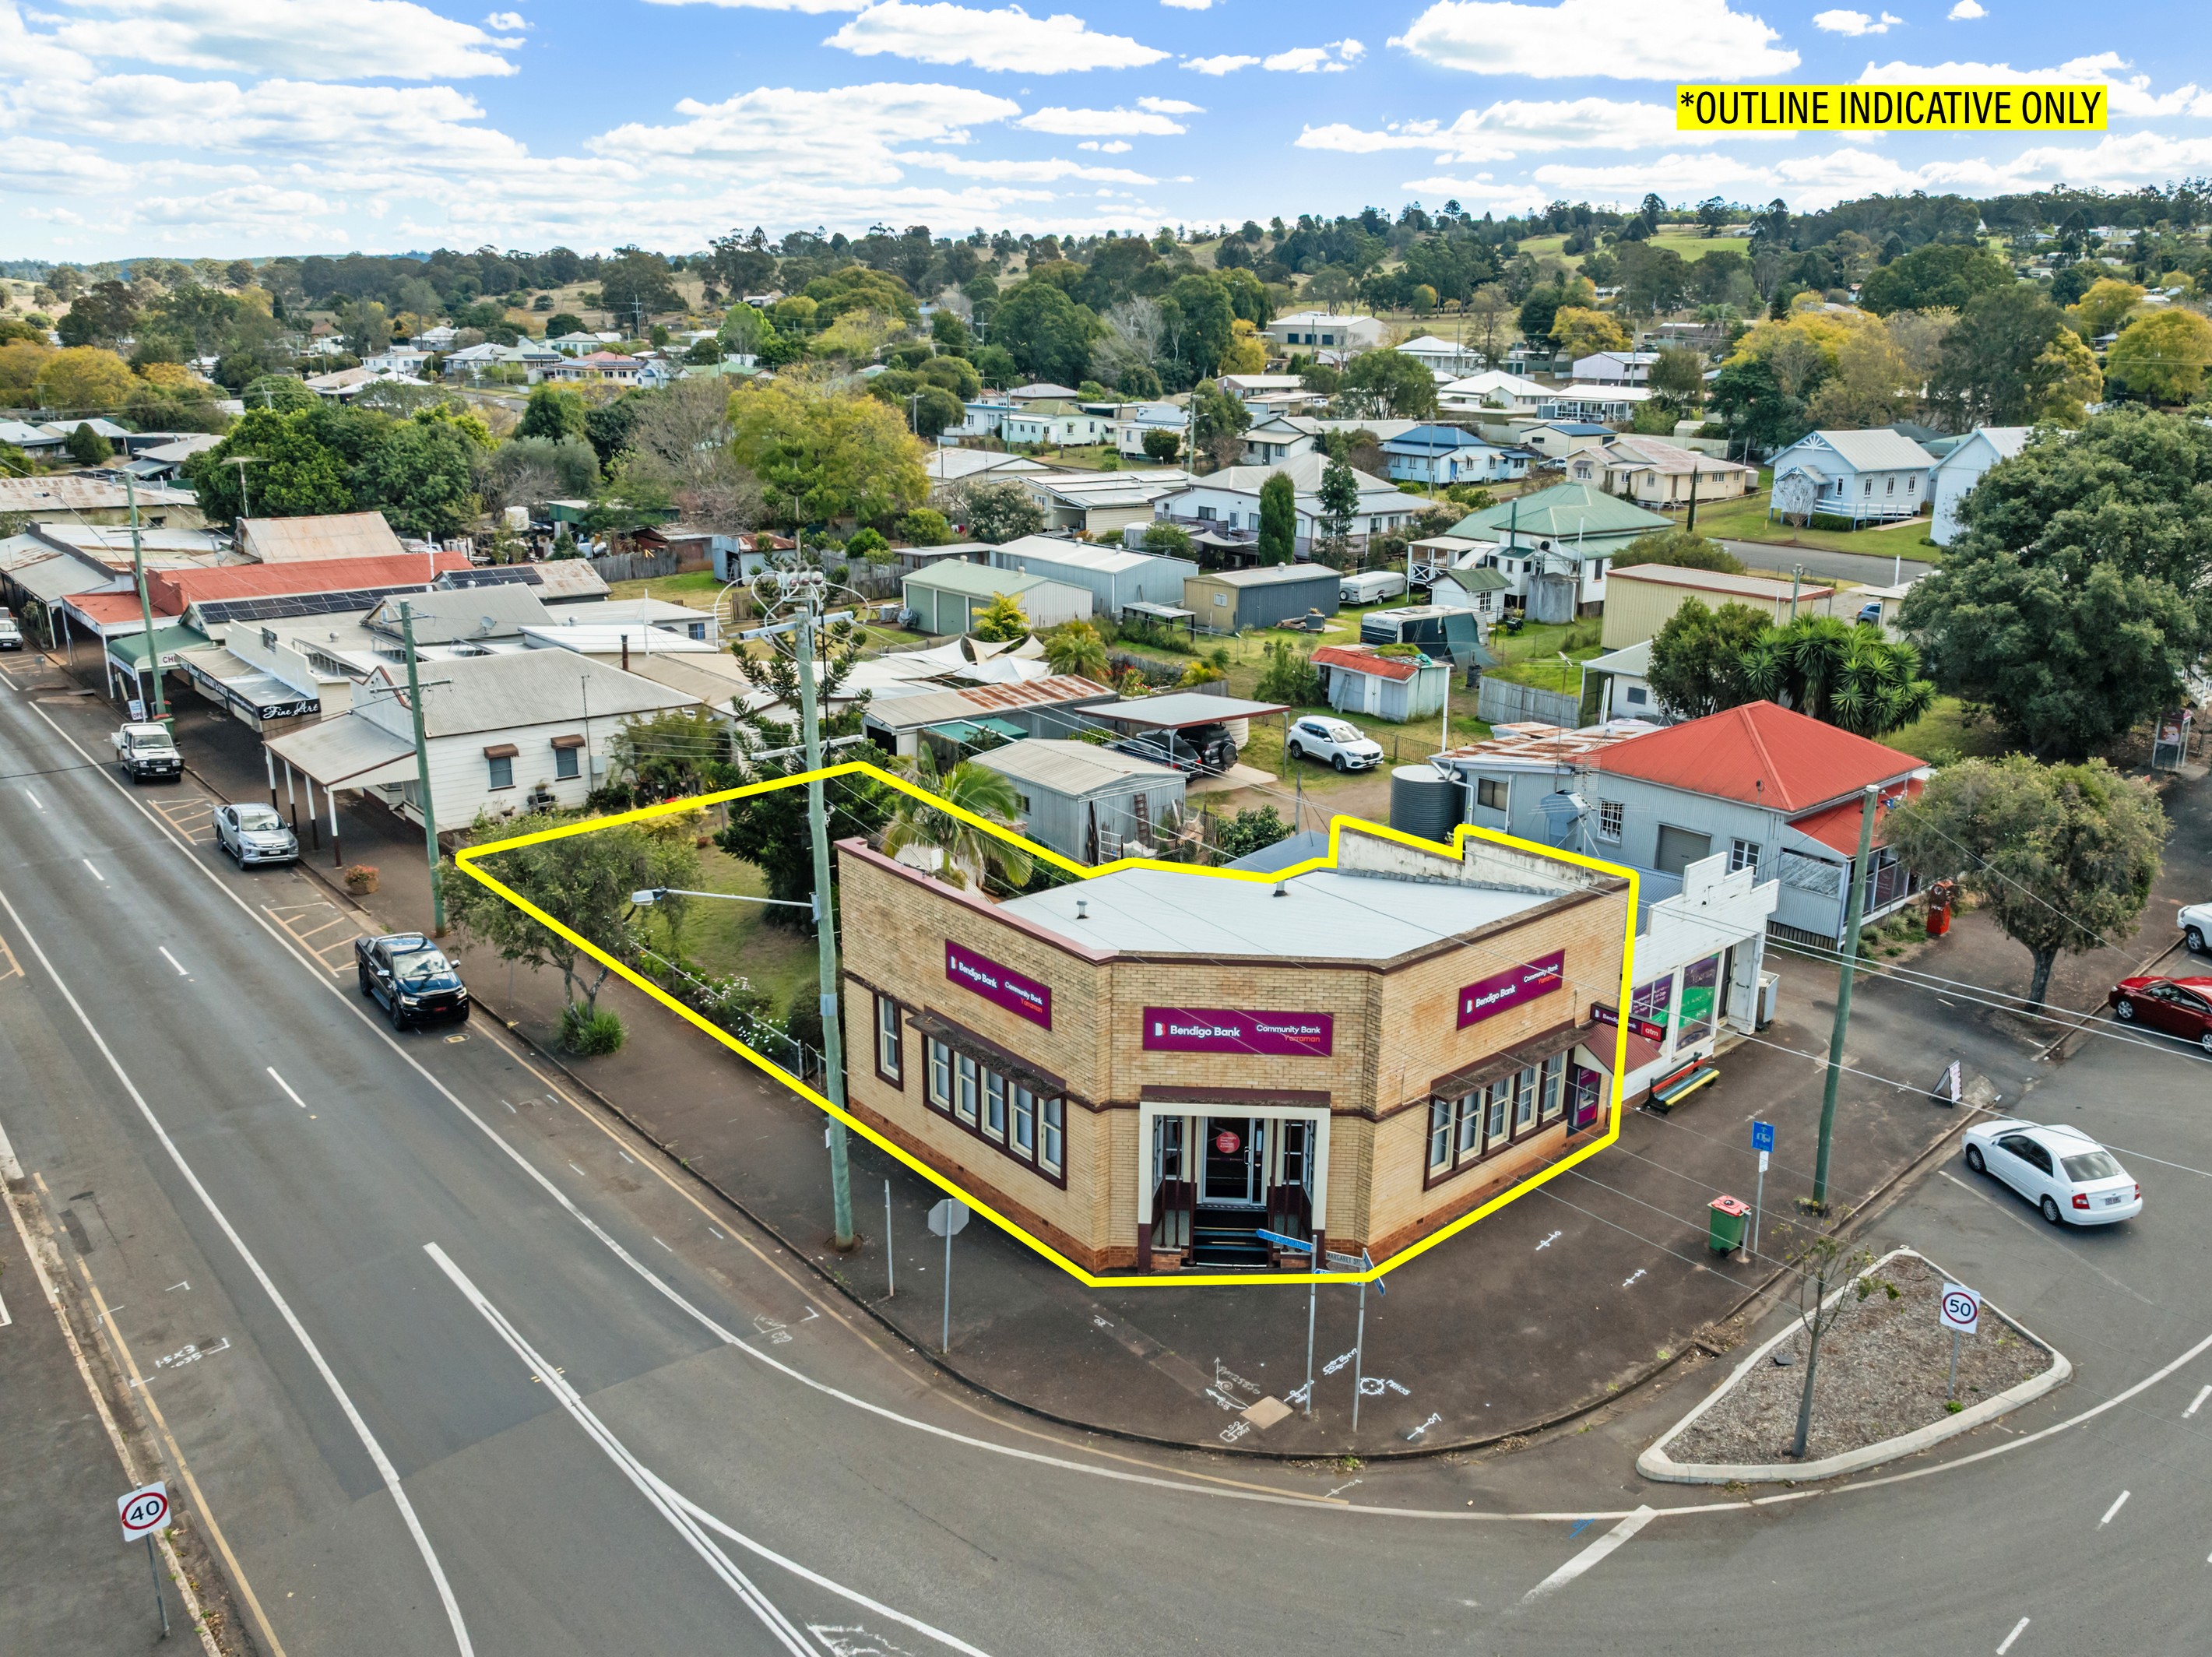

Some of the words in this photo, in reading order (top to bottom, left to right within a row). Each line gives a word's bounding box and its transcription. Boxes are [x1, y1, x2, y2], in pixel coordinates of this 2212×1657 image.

[262, 705, 292, 719] Fine
[291, 700, 319, 716] Art
[958, 962, 981, 981] Bendigo
[981, 973, 997, 989] Bank
[1004, 981, 1030, 1000] Community
[1030, 994, 1043, 1005] Bank
[1475, 993, 1500, 1008] Bendigo
[1500, 984, 1516, 997] Bank
[1169, 1025, 1212, 1038] Bendigo
[1214, 1026, 1240, 1037] Bank
[1256, 1024, 1299, 1036] Community
[1301, 1026, 1321, 1034] Bank
[1644, 1028, 1658, 1037] atm
[1263, 1232, 1310, 1250] SHOWGROUNDS
[1326, 1252, 1352, 1265] MARGARET
[1949, 1299, 1971, 1317] 50
[129, 1500, 160, 1521] 40
